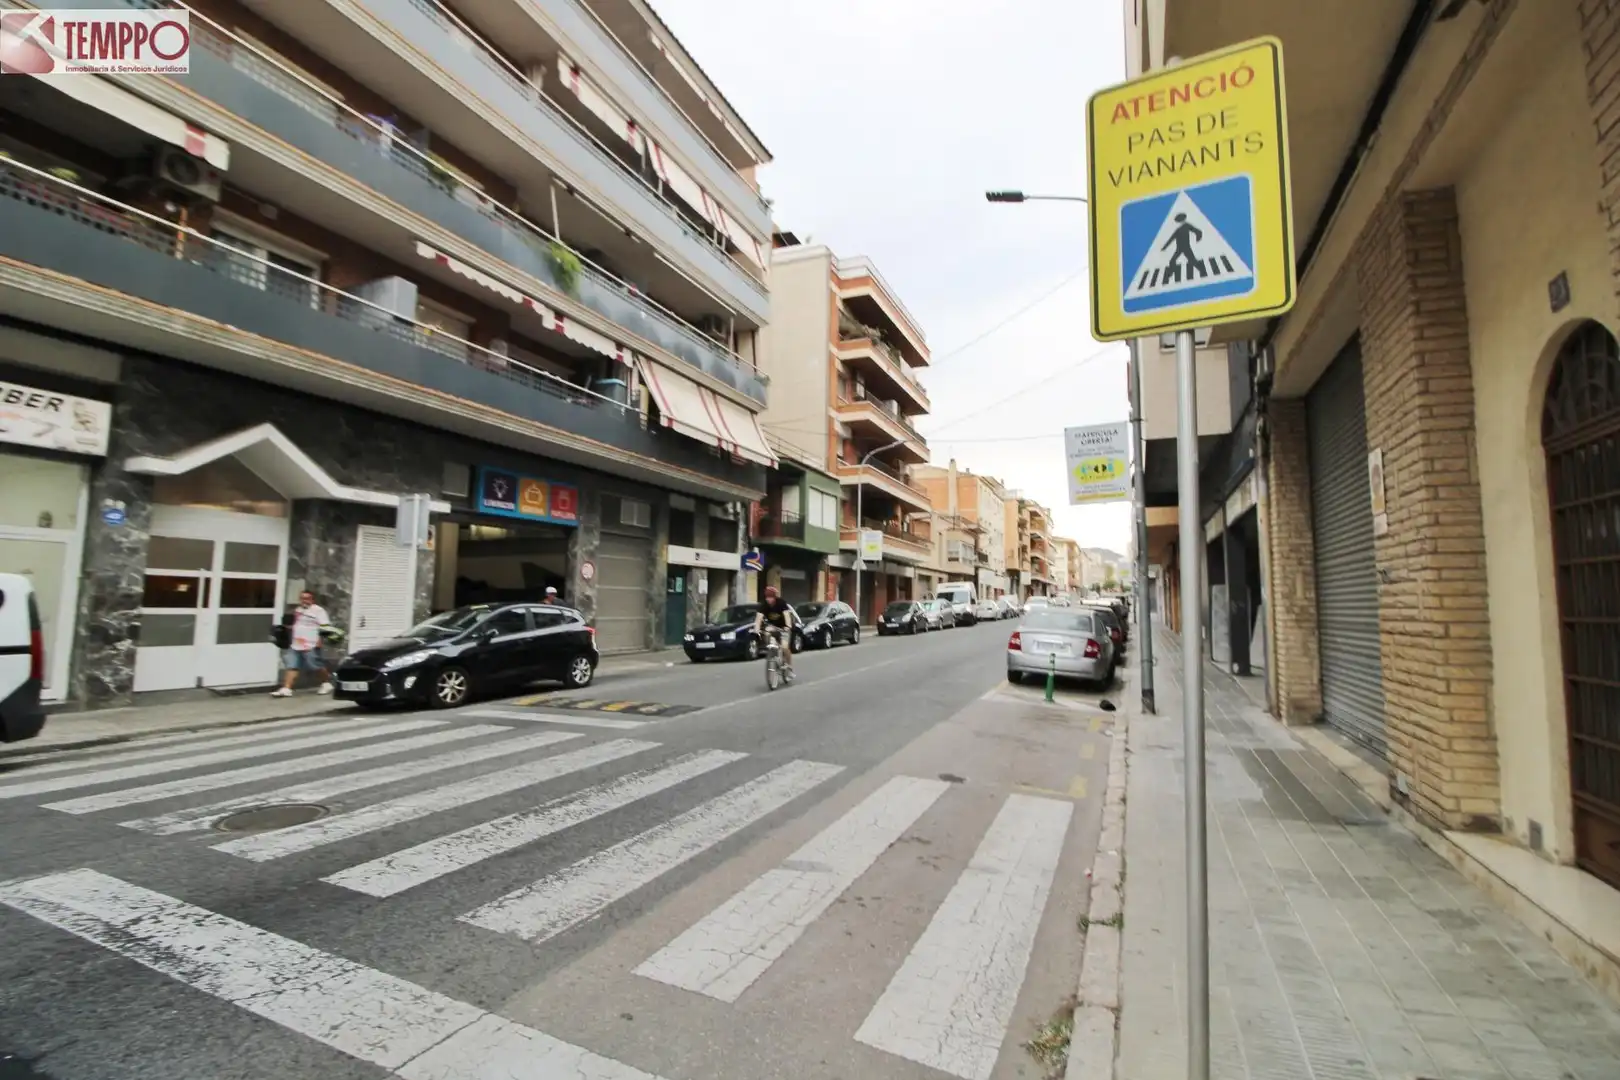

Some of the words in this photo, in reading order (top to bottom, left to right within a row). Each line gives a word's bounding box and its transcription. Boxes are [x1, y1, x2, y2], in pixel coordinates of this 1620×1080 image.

[1110, 61, 1255, 125] ATENCIÓ
[1128, 121, 1186, 155] PAS
[1197, 106, 1240, 136] DE
[1108, 131, 1265, 188] VIANANTS
